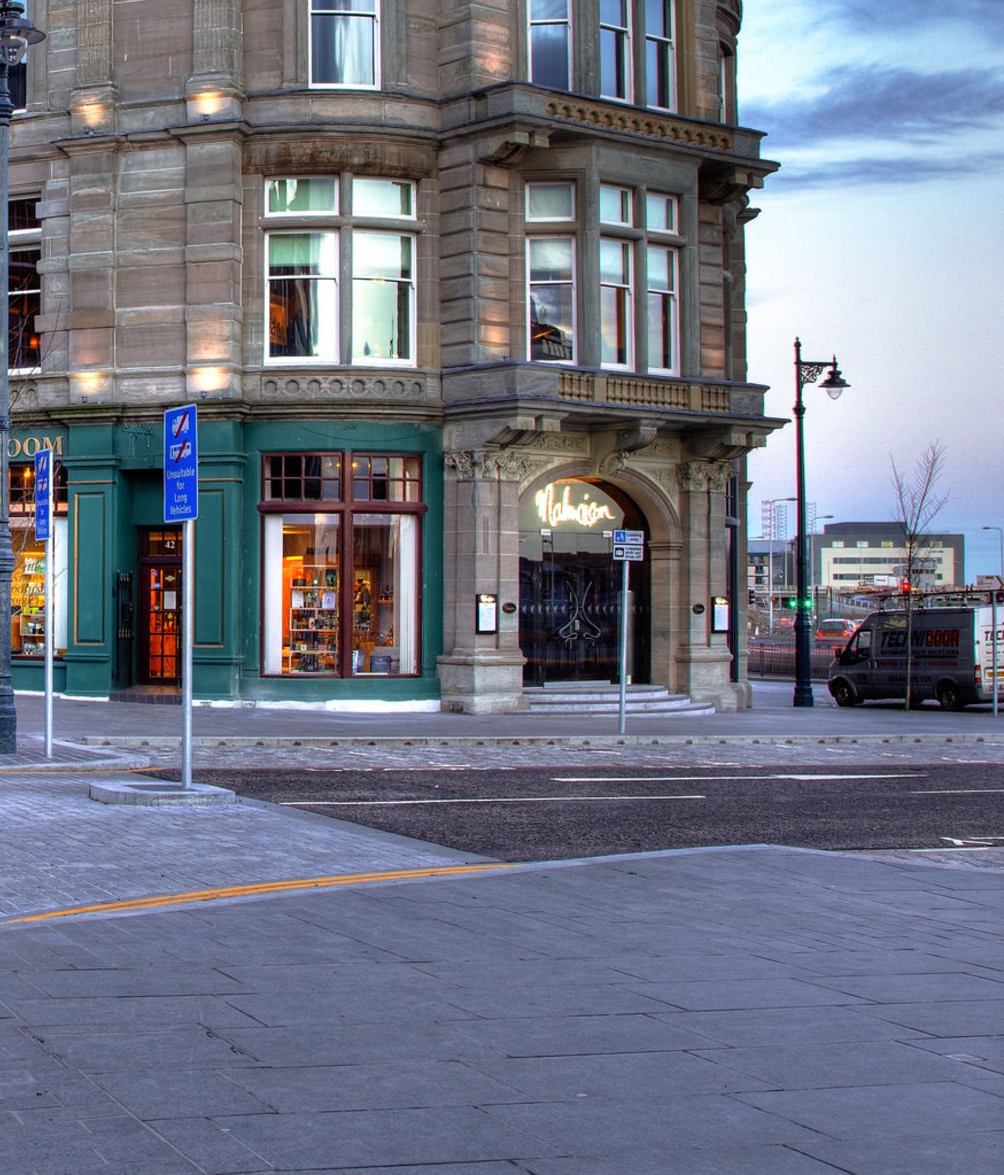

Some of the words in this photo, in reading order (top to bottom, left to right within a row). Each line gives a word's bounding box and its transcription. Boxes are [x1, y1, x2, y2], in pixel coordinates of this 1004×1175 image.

[167, 468, 195, 480] Unsuitable
[177, 481, 185, 490] for
[174, 494, 187, 504] Long
[170, 505, 192, 516] Vehicles
[165, 541, 175, 549] 42
